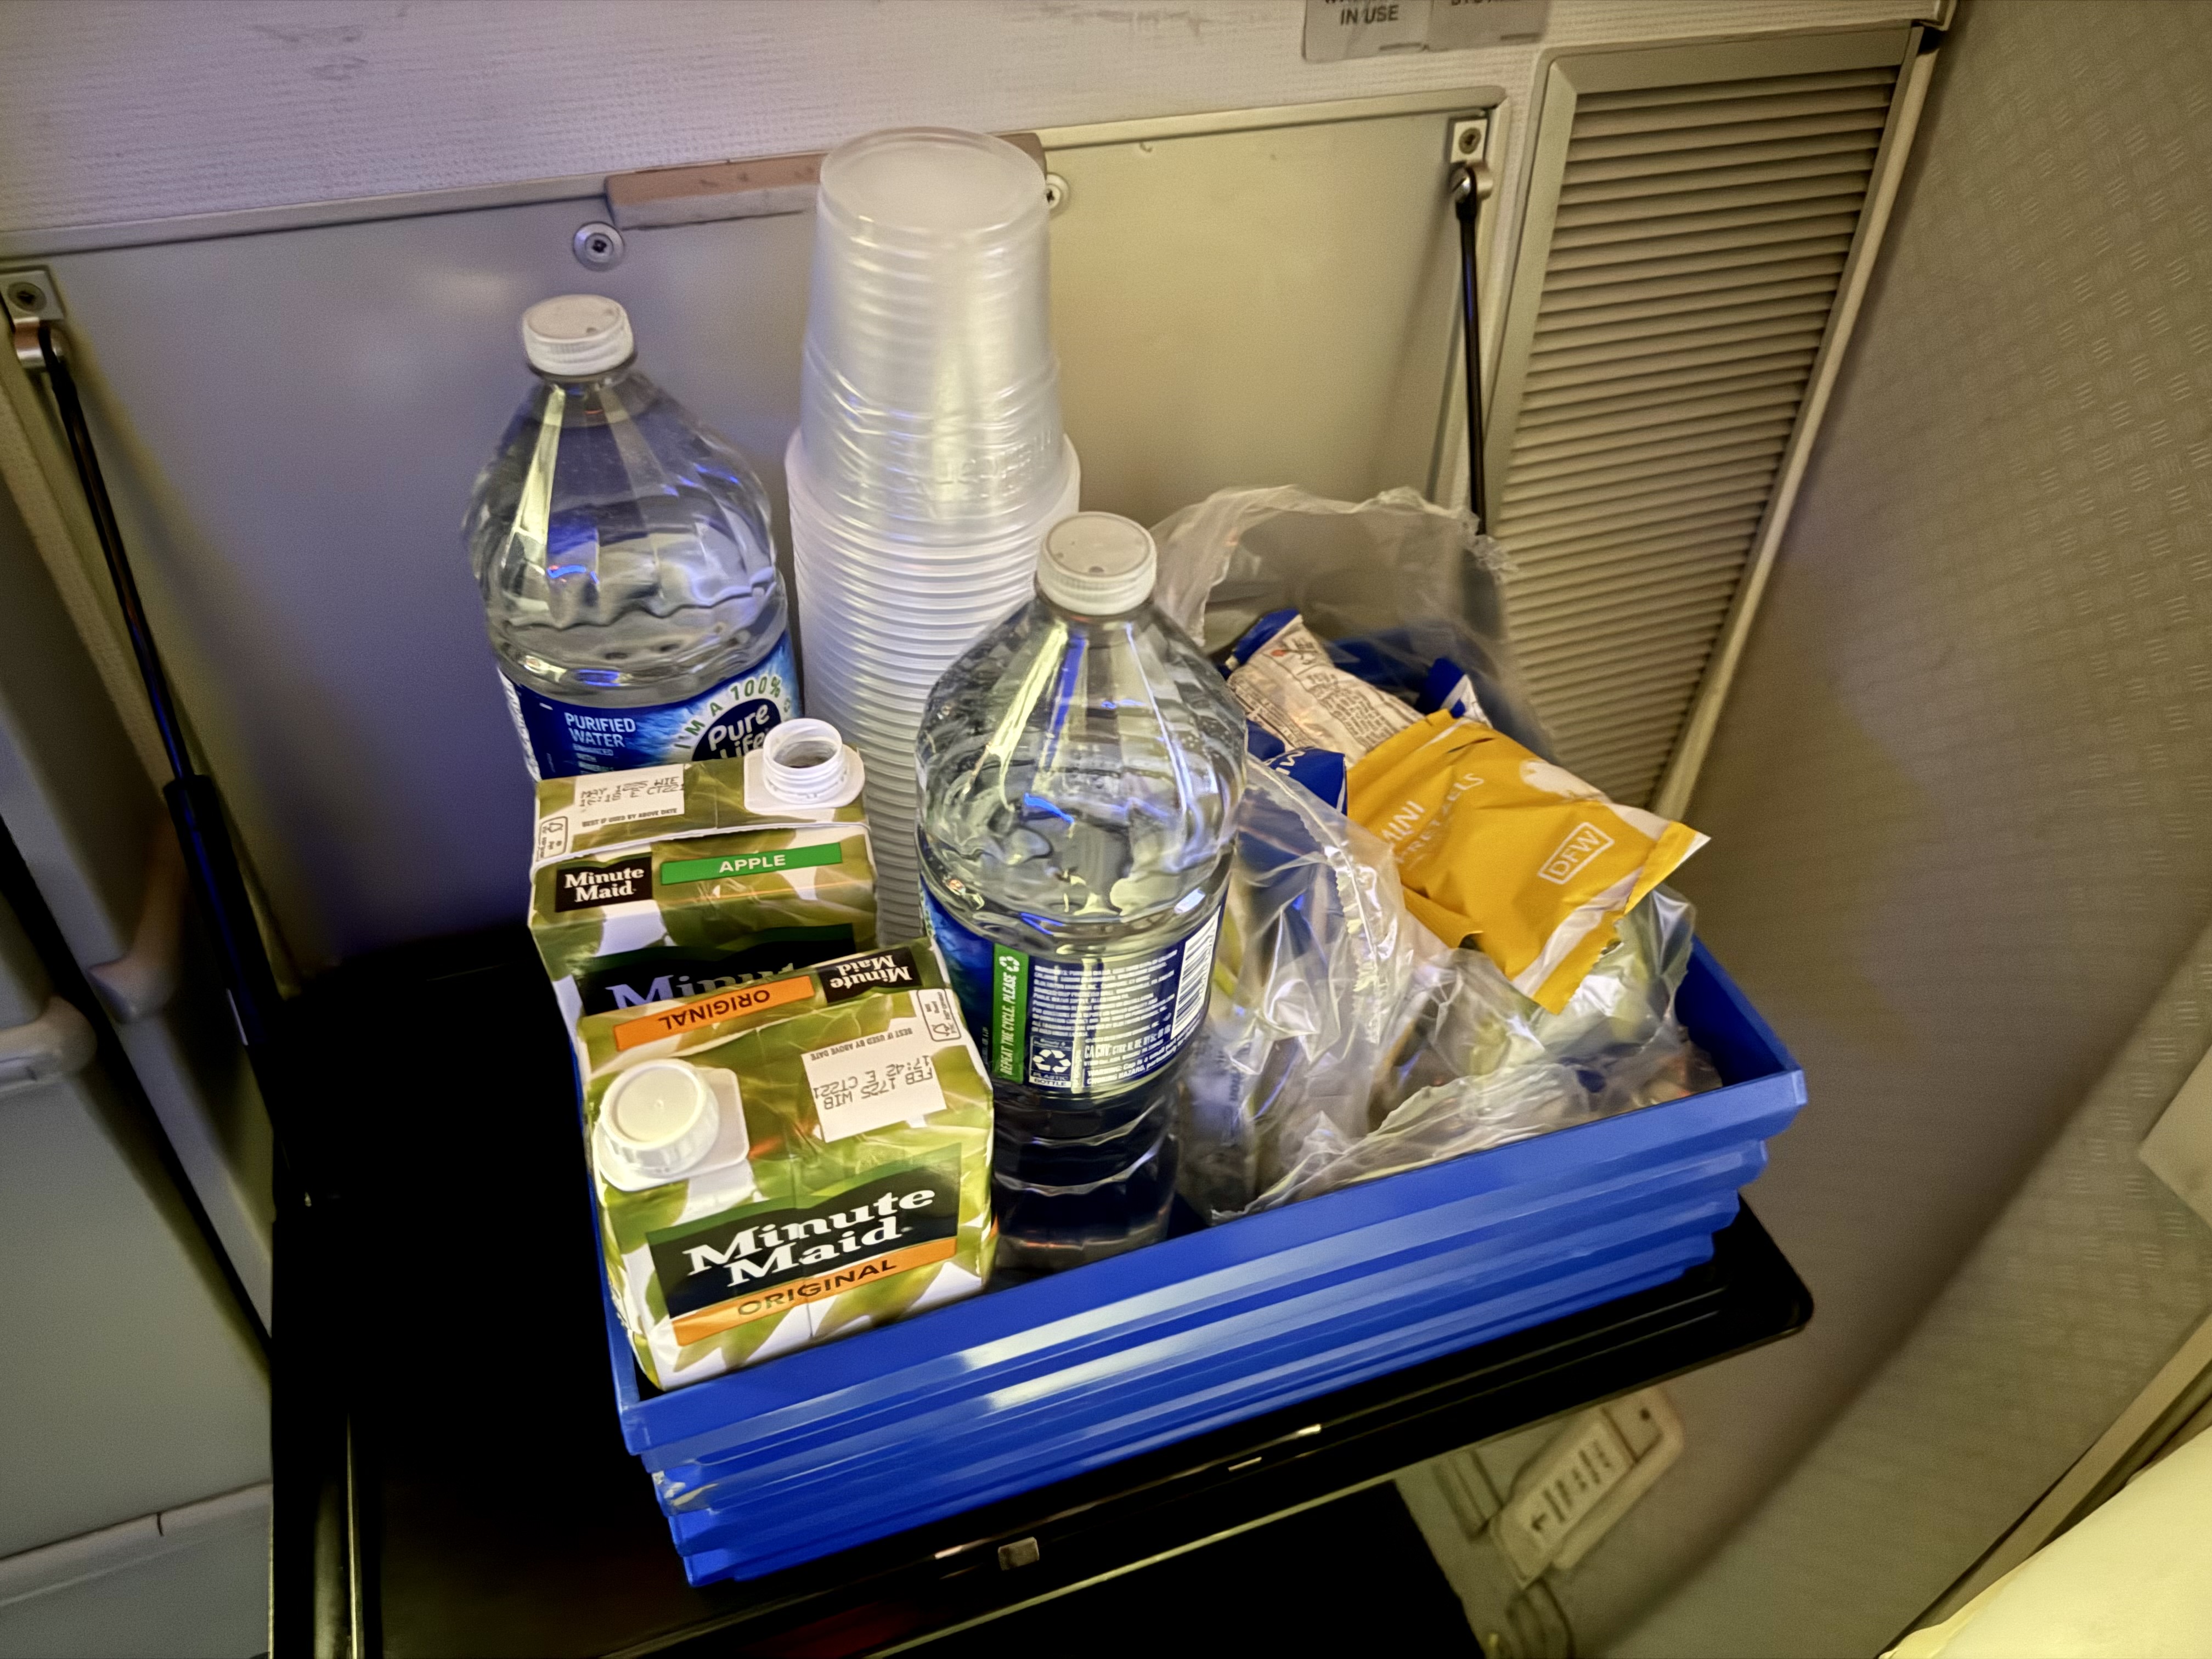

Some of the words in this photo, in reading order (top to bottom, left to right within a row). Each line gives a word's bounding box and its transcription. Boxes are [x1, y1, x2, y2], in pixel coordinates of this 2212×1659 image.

[1341, 8, 1358, 25] IN
[1363, 4, 1399, 25] USE
[709, 701, 724, 718] A
[730, 676, 781, 701] 100%
[565, 712, 636, 733] PURIFIED
[708, 704, 770, 752] Pure
[568, 727, 625, 748] WATER
[580, 788, 608, 799] MAY
[719, 854, 786, 873] APPLE
[1549, 830, 1600, 876] DFW
[565, 867, 645, 889] Minute
[574, 882, 633, 902] Maid
[837, 953, 896, 978] Maid
[830, 963, 913, 990] Minute
[1002, 972, 1017, 1005] PLEASE
[658, 989, 771, 1030] ORIGINAL
[866, 1034, 885, 1046] USED
[895, 1027, 913, 1038] BEST
[1001, 1031, 1015, 1046] THE
[831, 1042, 854, 1056] ABOVE
[855, 1039, 866, 1048] BY
[810, 1049, 830, 1061] DATE
[885, 1054, 931, 1077] 17:42
[1000, 1045, 1014, 1076] REPEAT
[865, 1070, 876, 1084] E
[905, 1067, 934, 1086] FEB
[1034, 1078, 1066, 1086] BOTTLE
[812, 1075, 859, 1100] CT221
[860, 1076, 896, 1100] 1725
[823, 1091, 854, 1110] WIB
[681, 1188, 935, 1276] Minute
[723, 1216, 903, 1288] Maid
[737, 1259, 898, 1316] ORIGINAL
